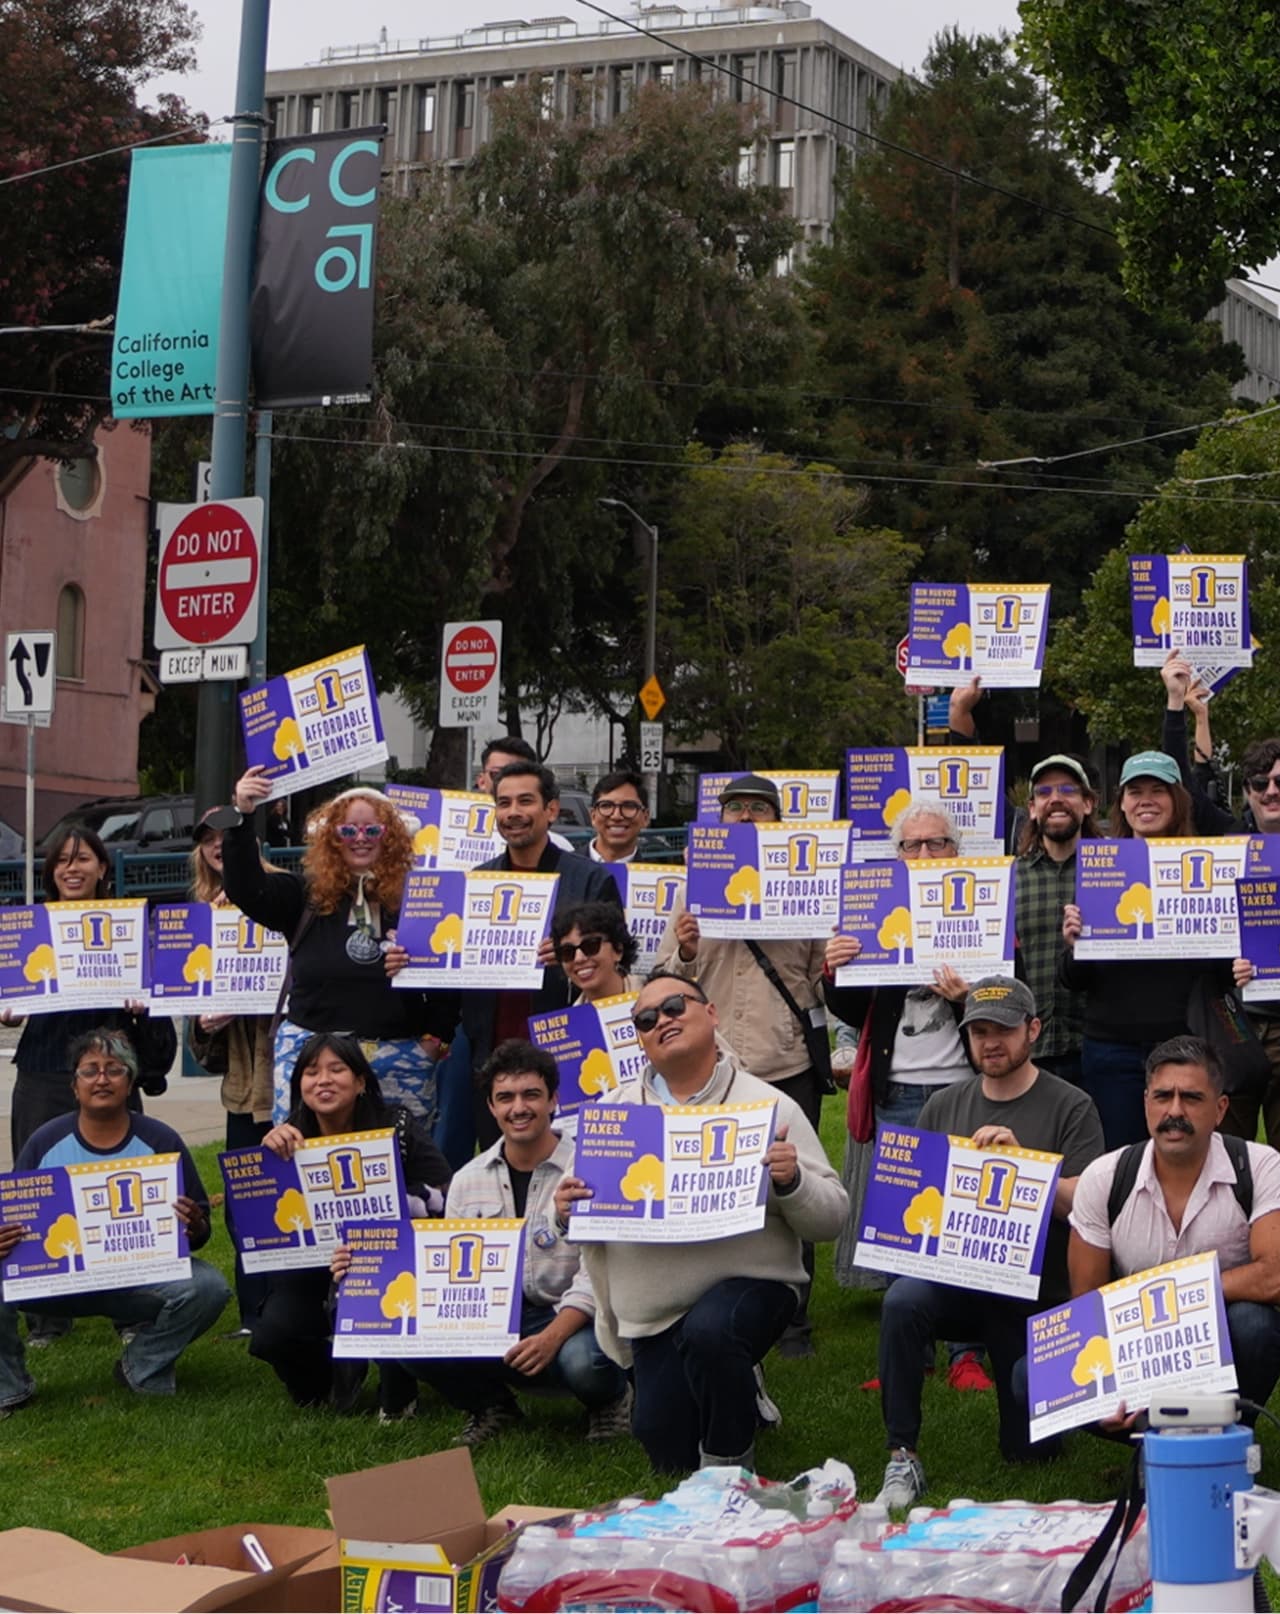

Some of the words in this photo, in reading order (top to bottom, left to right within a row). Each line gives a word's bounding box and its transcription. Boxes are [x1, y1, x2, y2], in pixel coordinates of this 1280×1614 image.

[117, 329, 209, 354] California
[116, 360, 185, 382] College
[117, 385, 136, 405] of
[142, 384, 175, 404] the
[180, 382, 216, 401] Art
[176, 533, 200, 556] DO
[207, 528, 243, 554] NOT
[1172, 585, 1189, 595] YES
[1217, 584, 1235, 594] YES
[178, 592, 234, 618] ENTER
[1173, 612, 1236, 627] AFFORDABLE
[456, 640, 468, 651] DO
[470, 640, 488, 650] NOT
[1187, 630, 1221, 645] HOMES
[211, 654, 239, 672] MUNI
[456, 670, 486, 682] ENTER
[452, 696, 487, 709] EXCEPT
[457, 710, 480, 722] MUNI
[644, 751, 660, 768] 25
[766, 852, 787, 862] YES
[819, 852, 838, 862] YES
[765, 880, 837, 897] AFFORDABLE
[782, 899, 821, 915] HOMES
[106, 1219, 151, 1237] VIVIENDA
[104, 1233, 155, 1253] ASEQUIBLE
